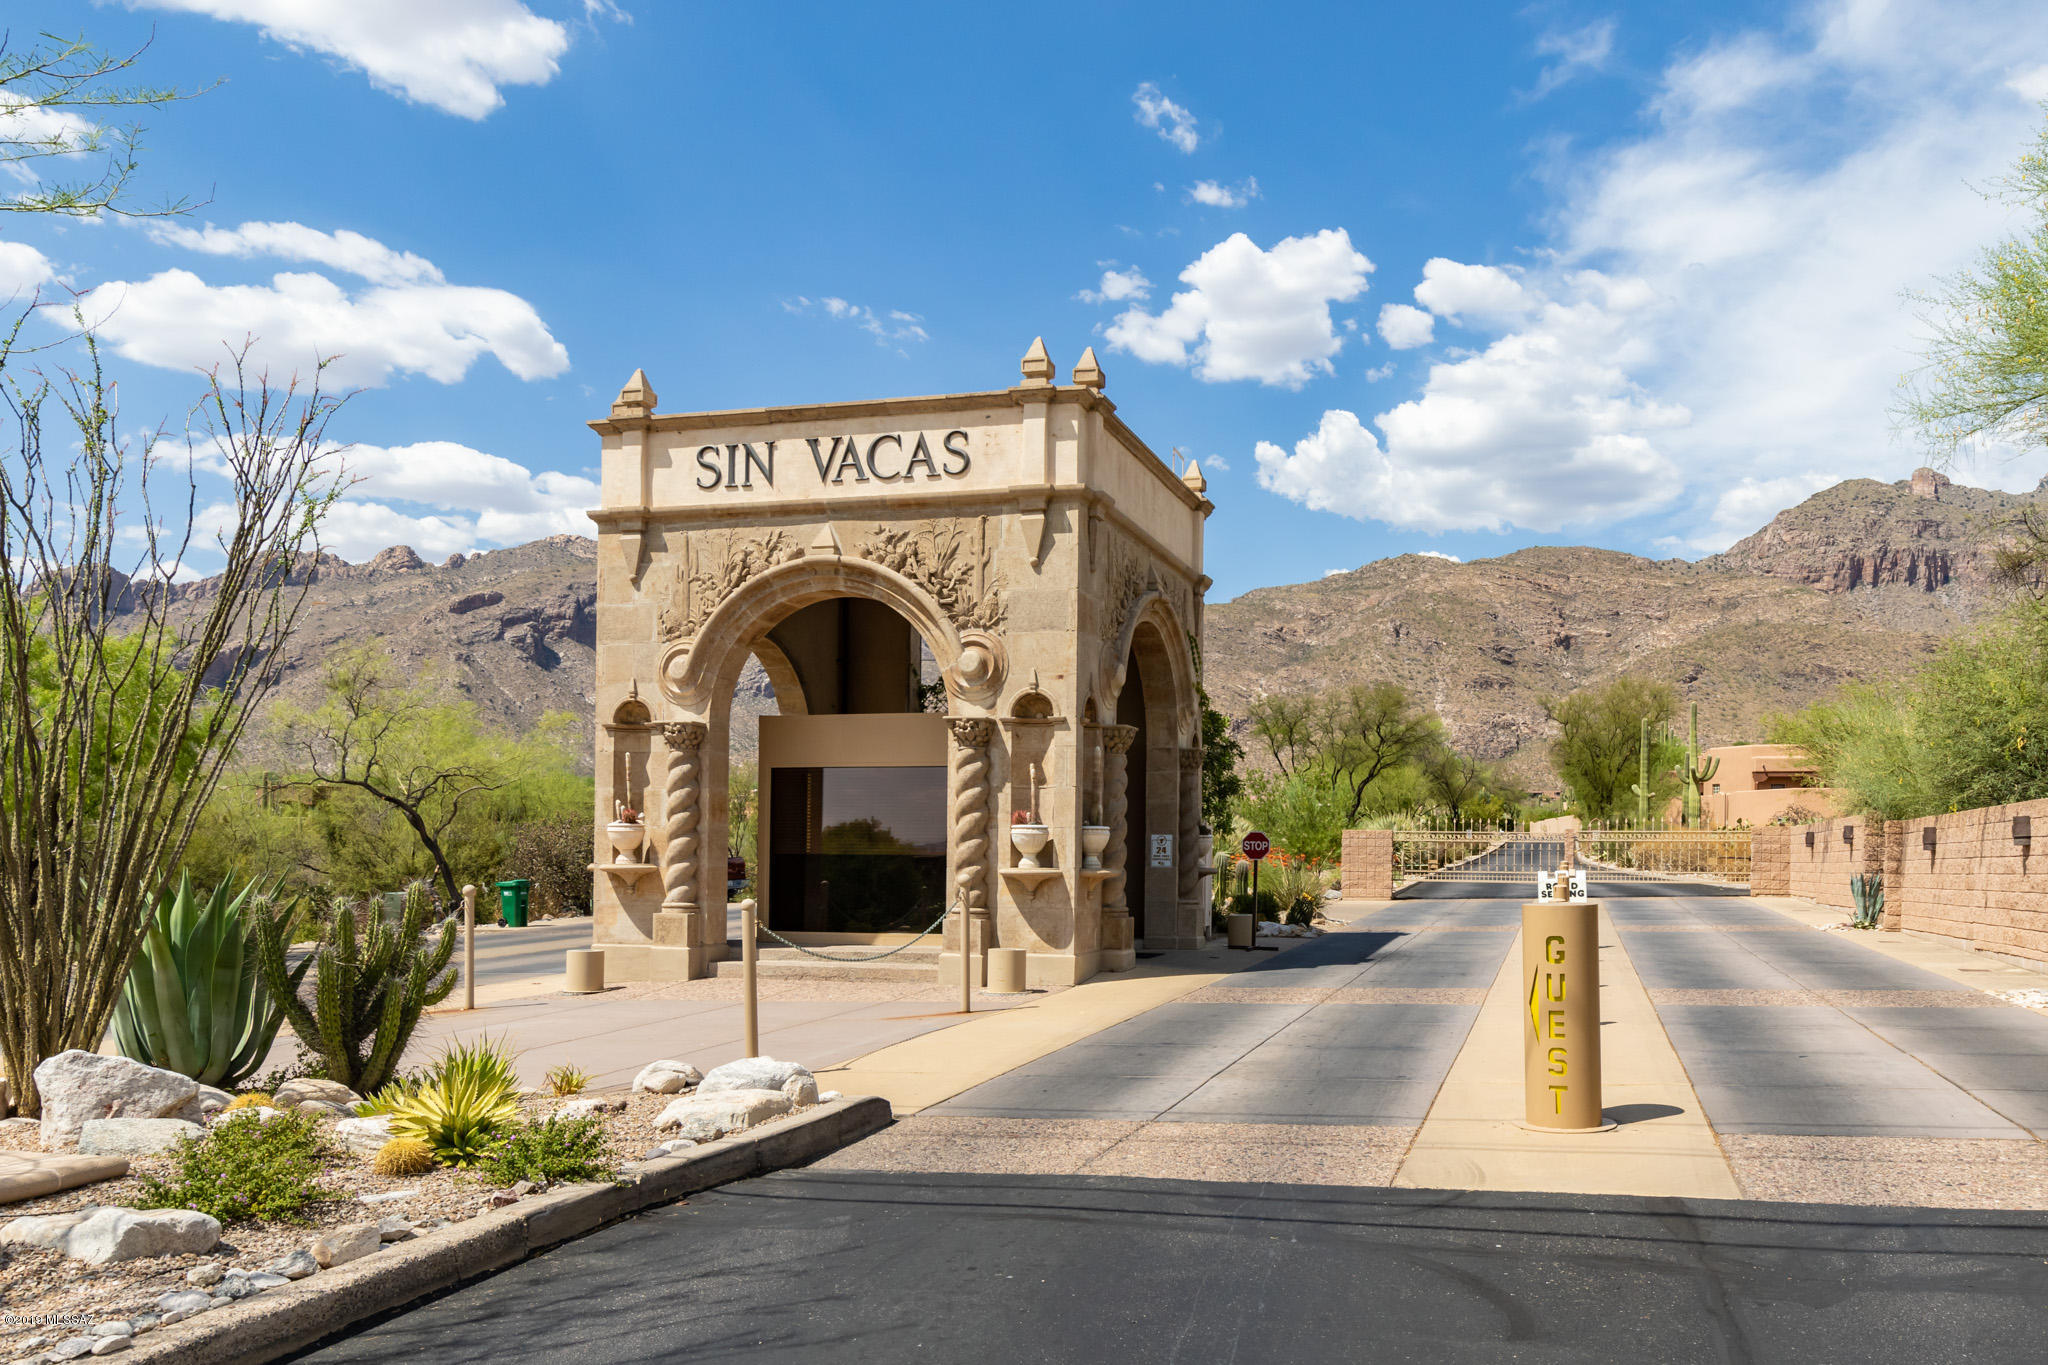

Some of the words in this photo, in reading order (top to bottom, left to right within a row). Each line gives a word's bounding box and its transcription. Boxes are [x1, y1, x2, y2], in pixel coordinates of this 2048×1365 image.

[696, 440, 776, 490] SIN
[805, 430, 971, 484] VACAS
[1156, 846, 1167, 854] 24
[1546, 882, 1578, 890] RD
[1541, 890, 1585, 898] SENG
[1545, 935, 1569, 1115] GUEST
